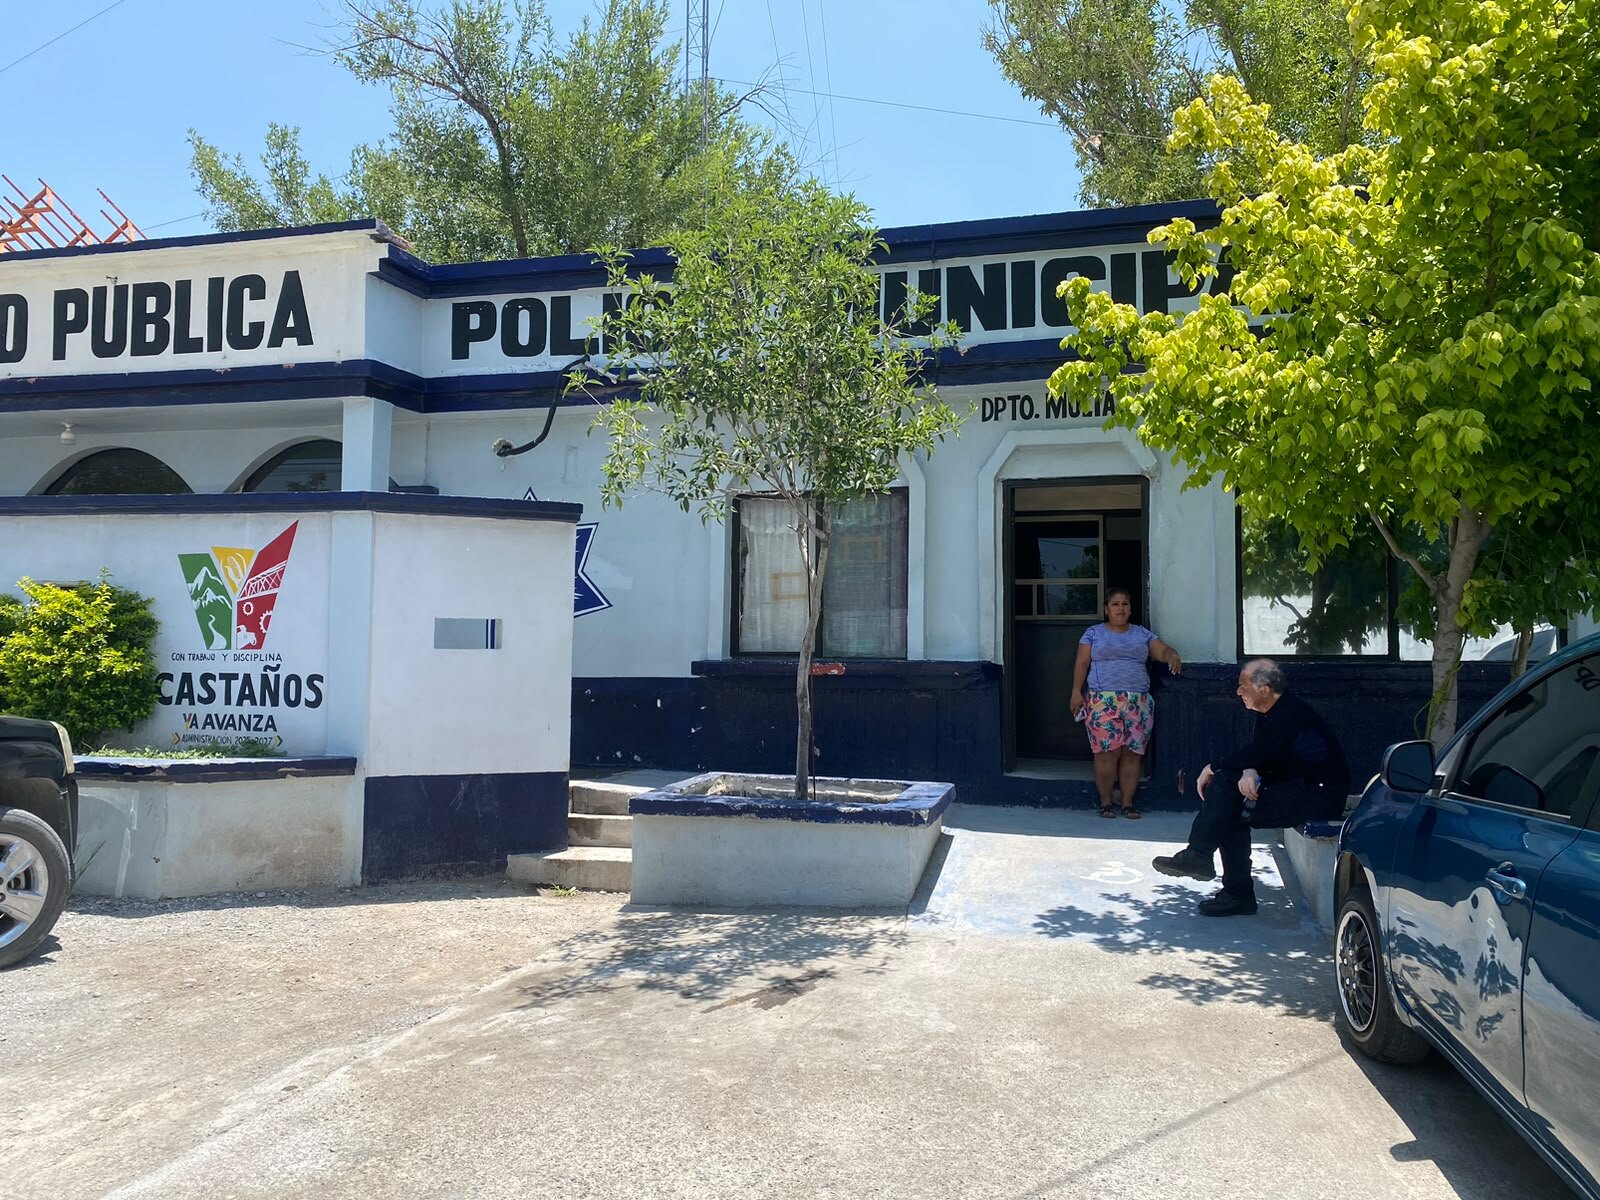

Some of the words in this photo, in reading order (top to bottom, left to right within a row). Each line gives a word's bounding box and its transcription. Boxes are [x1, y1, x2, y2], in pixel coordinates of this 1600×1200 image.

[981, 394, 1040, 422] DPTO.
[171, 652, 185, 661] CON
[188, 653, 216, 661] TRABAJO
[222, 653, 228, 661] Y
[233, 653, 283, 662] DISCIPLINA
[154, 663, 325, 709] CASTAÑOS
[201, 713, 278, 733] AVANZA
